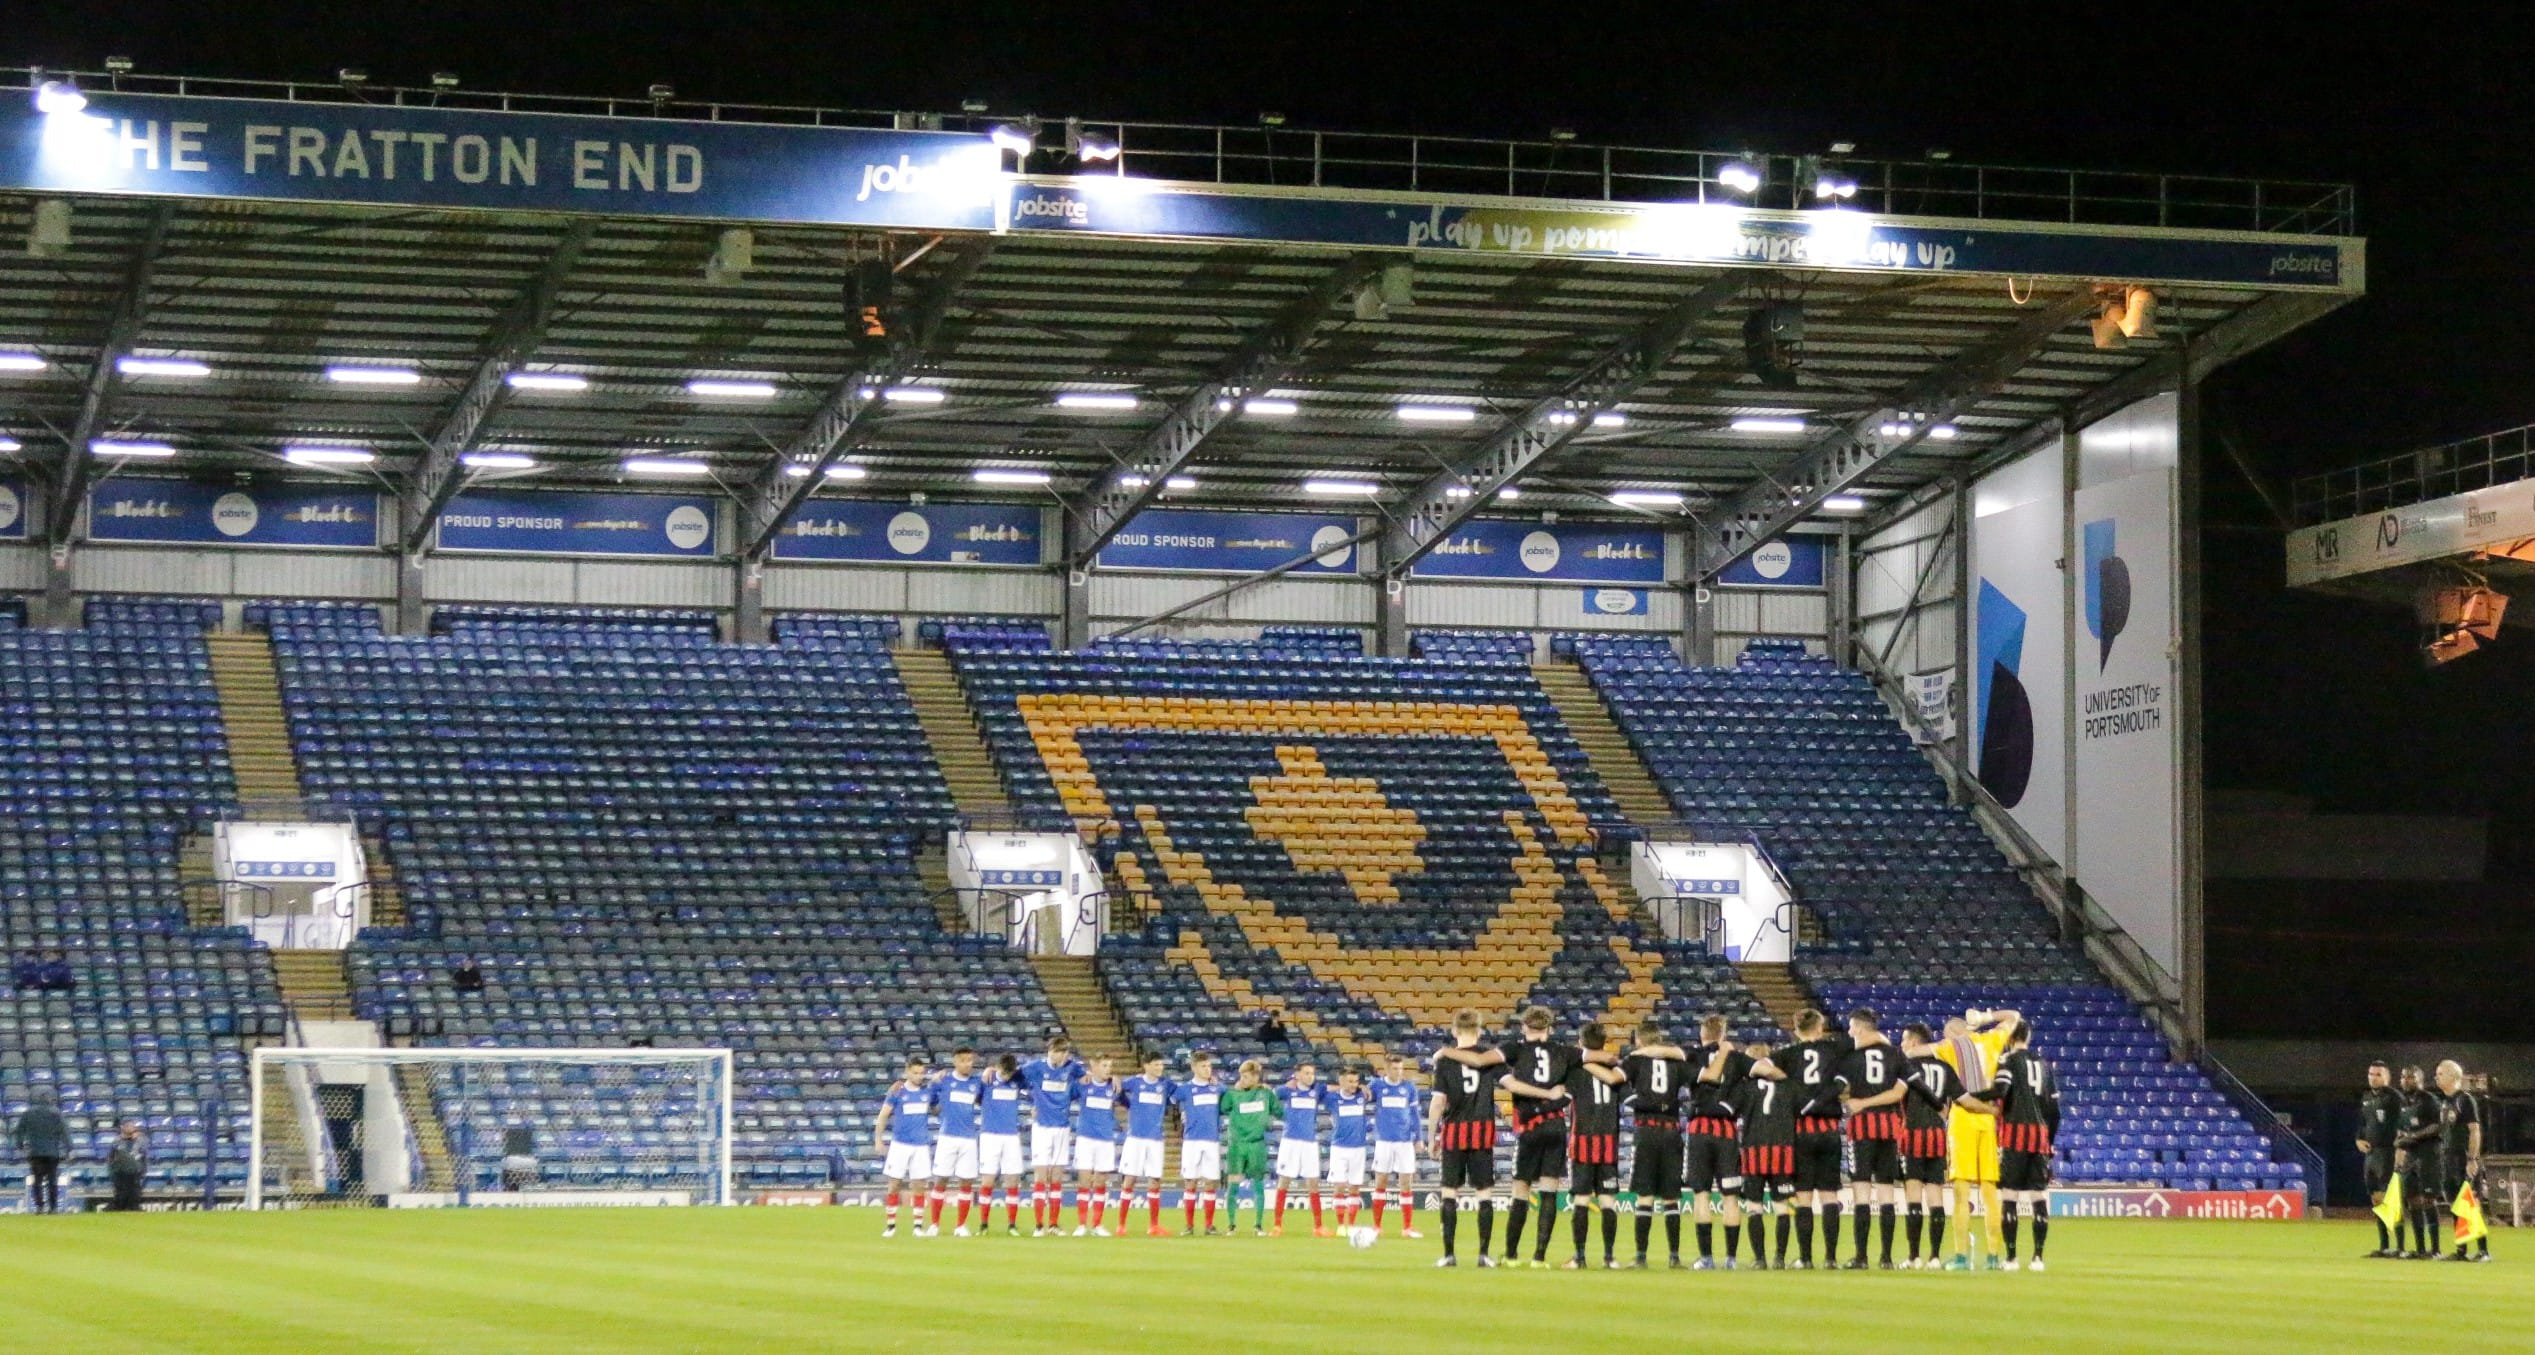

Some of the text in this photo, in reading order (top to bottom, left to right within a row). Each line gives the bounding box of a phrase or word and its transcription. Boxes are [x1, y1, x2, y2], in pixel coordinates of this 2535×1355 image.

[244, 124, 537, 186] FRATTON
[573, 140, 702, 193] END
[1015, 194, 1088, 221] jobsite
[1493, 222, 1533, 250] up
[1917, 241, 1955, 270] up
[2269, 251, 2333, 276] jobsite
[444, 515, 563, 530] PROUD SPONSOR
[1112, 534, 1216, 548] ROUD SPONSOR
[1525, 544, 1555, 558] jobsite
[1597, 542, 1632, 560] Block
[2085, 682, 2161, 715] UNIVERSITY OF
[2085, 707, 2161, 740] PORTSMOUTH
[1534, 1047, 1550, 1083] 3
[1651, 1058, 1669, 1094] 8
[1803, 1049, 1821, 1085] 2
[1864, 1049, 1884, 1084] 6
[2026, 1059, 2042, 1096] 4
[1757, 1078, 1776, 1115] 7
[2062, 1197, 2142, 1217] utilita
[2187, 1199, 2265, 1218] utilita
